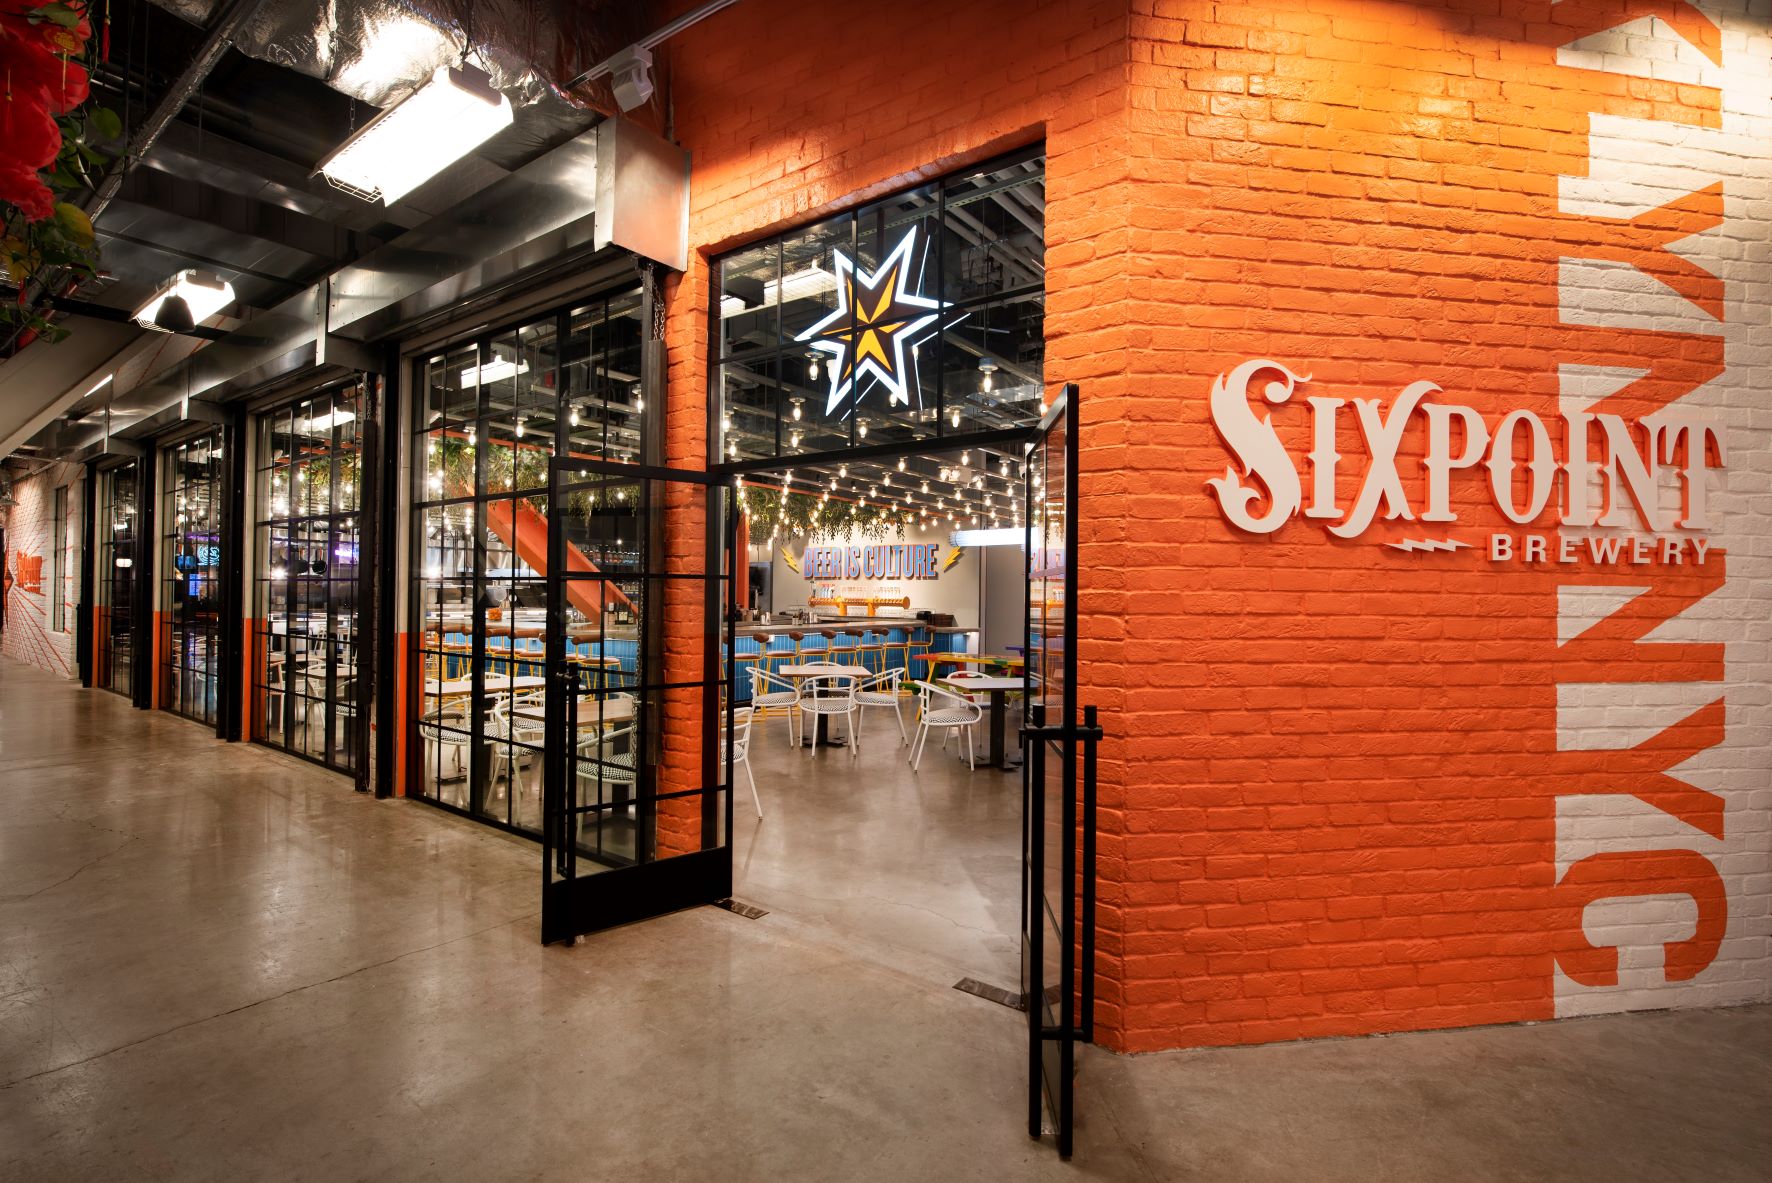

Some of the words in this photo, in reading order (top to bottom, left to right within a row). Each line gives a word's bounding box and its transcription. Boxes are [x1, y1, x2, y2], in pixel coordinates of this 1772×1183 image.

[1204, 359, 1728, 539] SIXPOINT
[804, 546, 842, 578] BEER
[845, 546, 860, 578] IS
[863, 544, 938, 578] CULTURE
[1492, 533, 1712, 565] BREWERY
[1554, 546, 1729, 987] NYC
